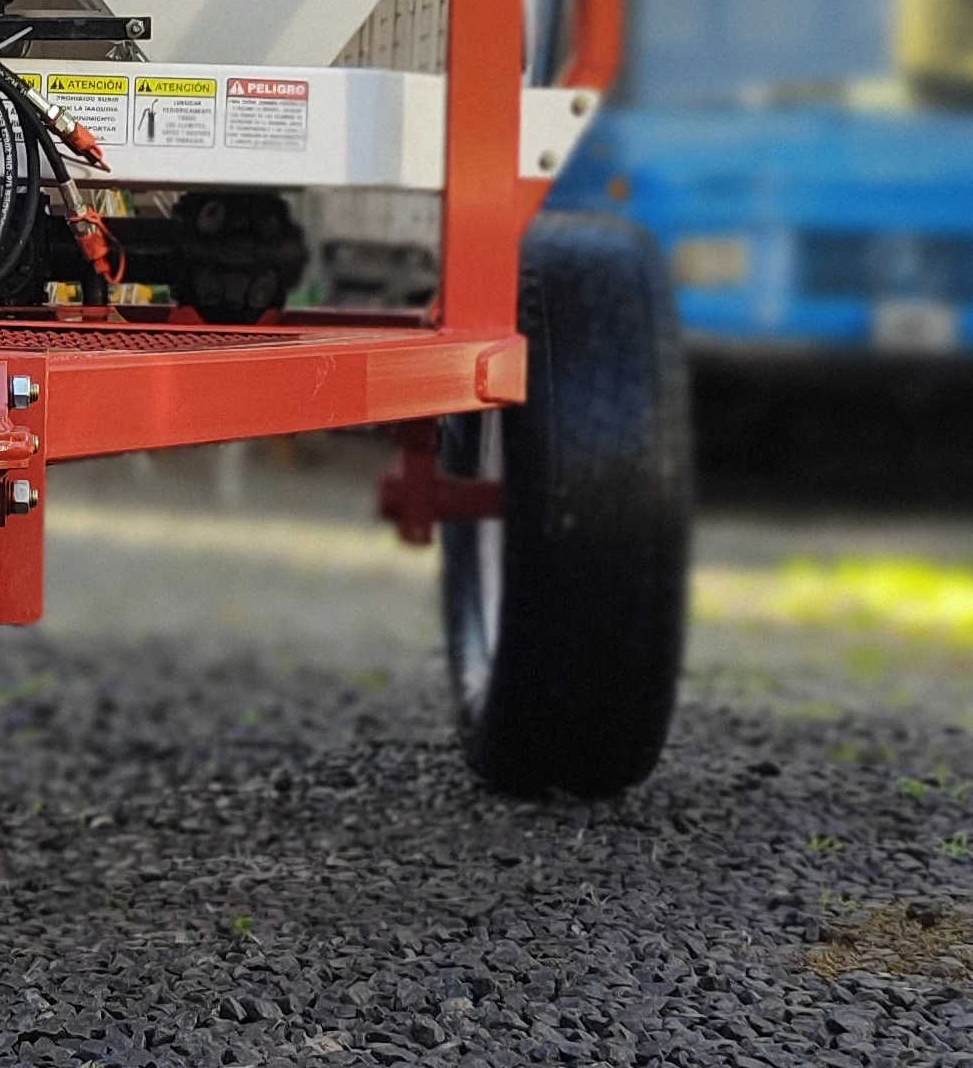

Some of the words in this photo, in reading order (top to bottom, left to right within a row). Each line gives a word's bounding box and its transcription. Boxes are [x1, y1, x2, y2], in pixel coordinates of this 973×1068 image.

[68, 79, 123, 90] ATENCIÓN
[155, 82, 210, 92] ATENCIÓN
[247, 82, 305, 95] PELIGRO
